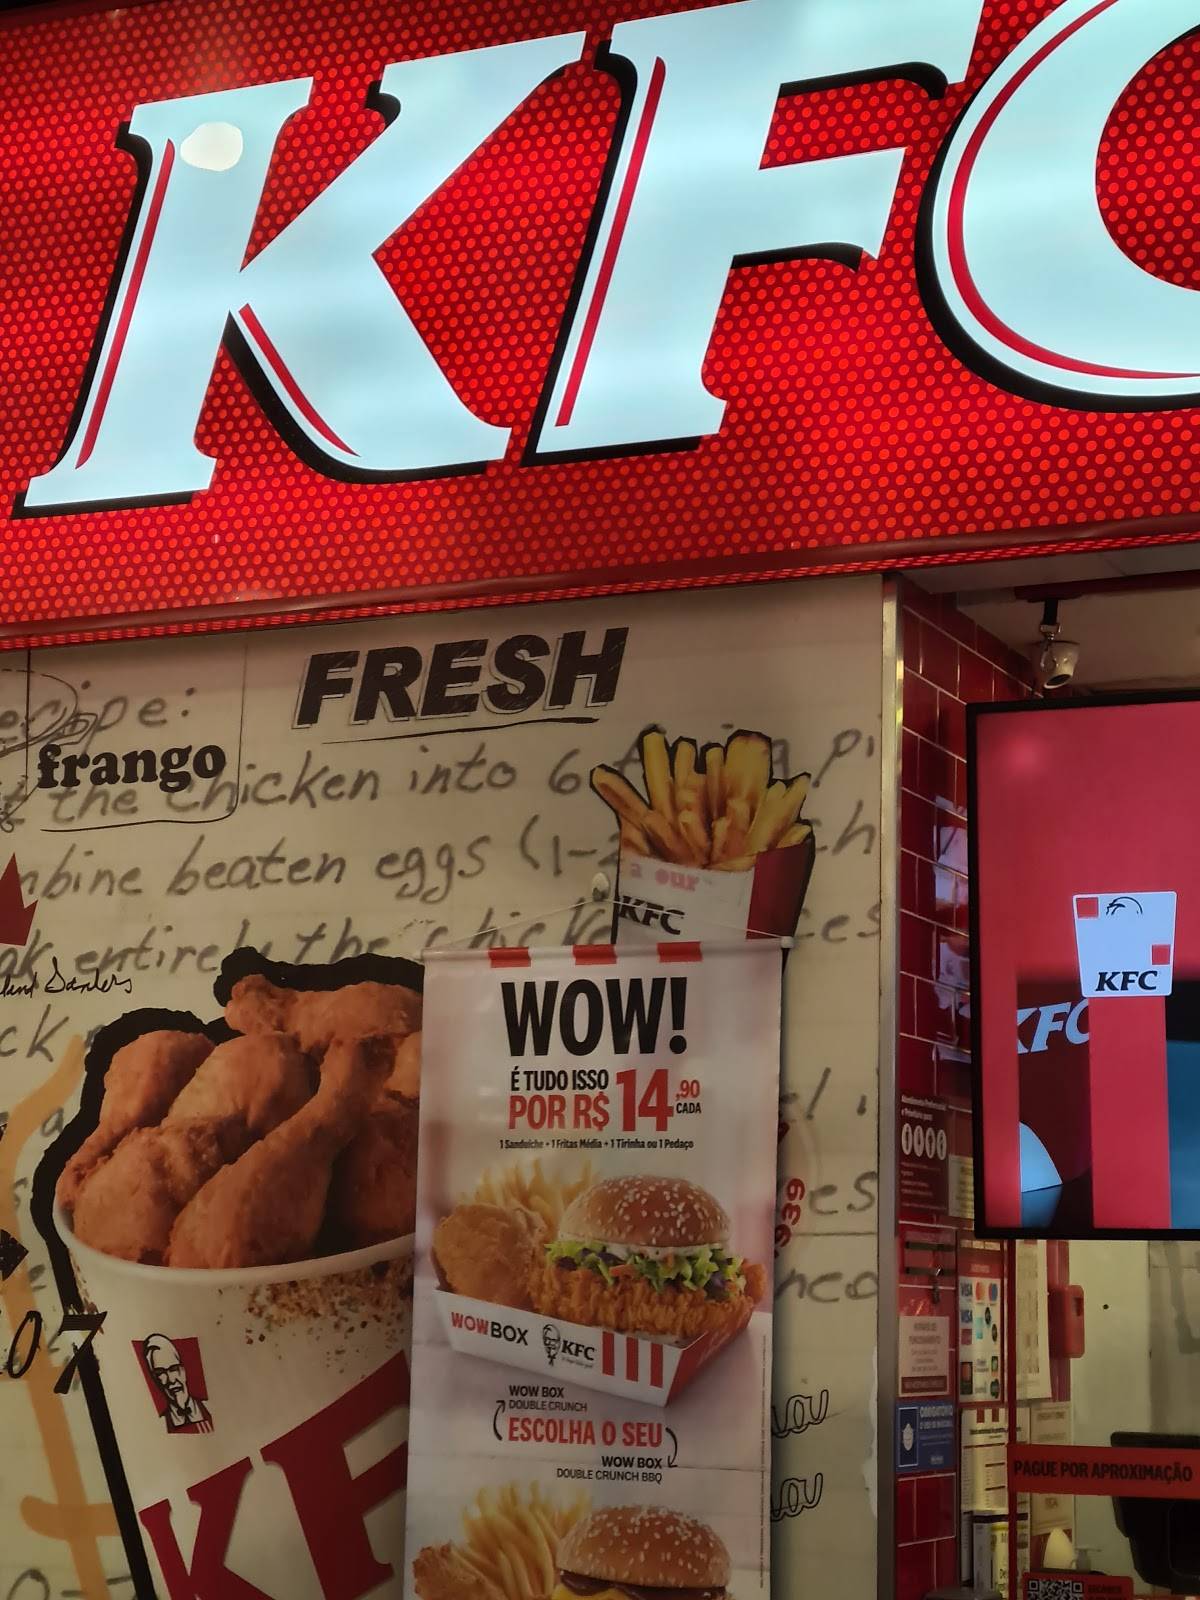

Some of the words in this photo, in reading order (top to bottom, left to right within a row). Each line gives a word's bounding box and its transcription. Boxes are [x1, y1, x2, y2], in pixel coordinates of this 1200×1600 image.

[13, 0, 1200, 519] KFC
[291, 627, 629, 730] FRESH
[37, 743, 227, 794] frango
[409, 742, 518, 795] into
[166, 834, 347, 896] beaten
[375, 835, 491, 904] eggs
[617, 894, 686, 936] KFC
[1095, 970, 1158, 992] KFC
[501, 977, 688, 1057] WOW!
[511, 1066, 521, 1091] É
[523, 1070, 569, 1091] TUDO
[572, 1069, 609, 1091] ISSO
[508, 1094, 567, 1130] POR
[573, 1091, 610, 1132] R$
[676, 1102, 702, 1114] CADA
[556, 1139, 578, 1149] Fritas
[616, 1138, 646, 1150] Tirinha
[647, 1141, 658, 1150] ou
[664, 1138, 694, 1151] Pedaço
[561, 1339, 595, 1361] KFC
[509, 1385, 538, 1397] WOW
[541, 1386, 564, 1398] BOX
[509, 1400, 547, 1411] DOUBLE
[548, 1401, 587, 1412] CRUNCH
[508, 1417, 596, 1445] ESCOLHA
[602, 1421, 616, 1446] O
[622, 1422, 663, 1448] SEU
[601, 1456, 634, 1468] WOW
[637, 1457, 662, 1469] BOX
[1013, 1460, 1058, 1478] PAGUE
[1060, 1461, 1088, 1477] POR
[1091, 1462, 1193, 1484] APROXIMAÇÃO
[556, 1468, 593, 1480] DOUBLE
[595, 1470, 639, 1481] CRUNCH
[642, 1472, 662, 1484] BBQ
